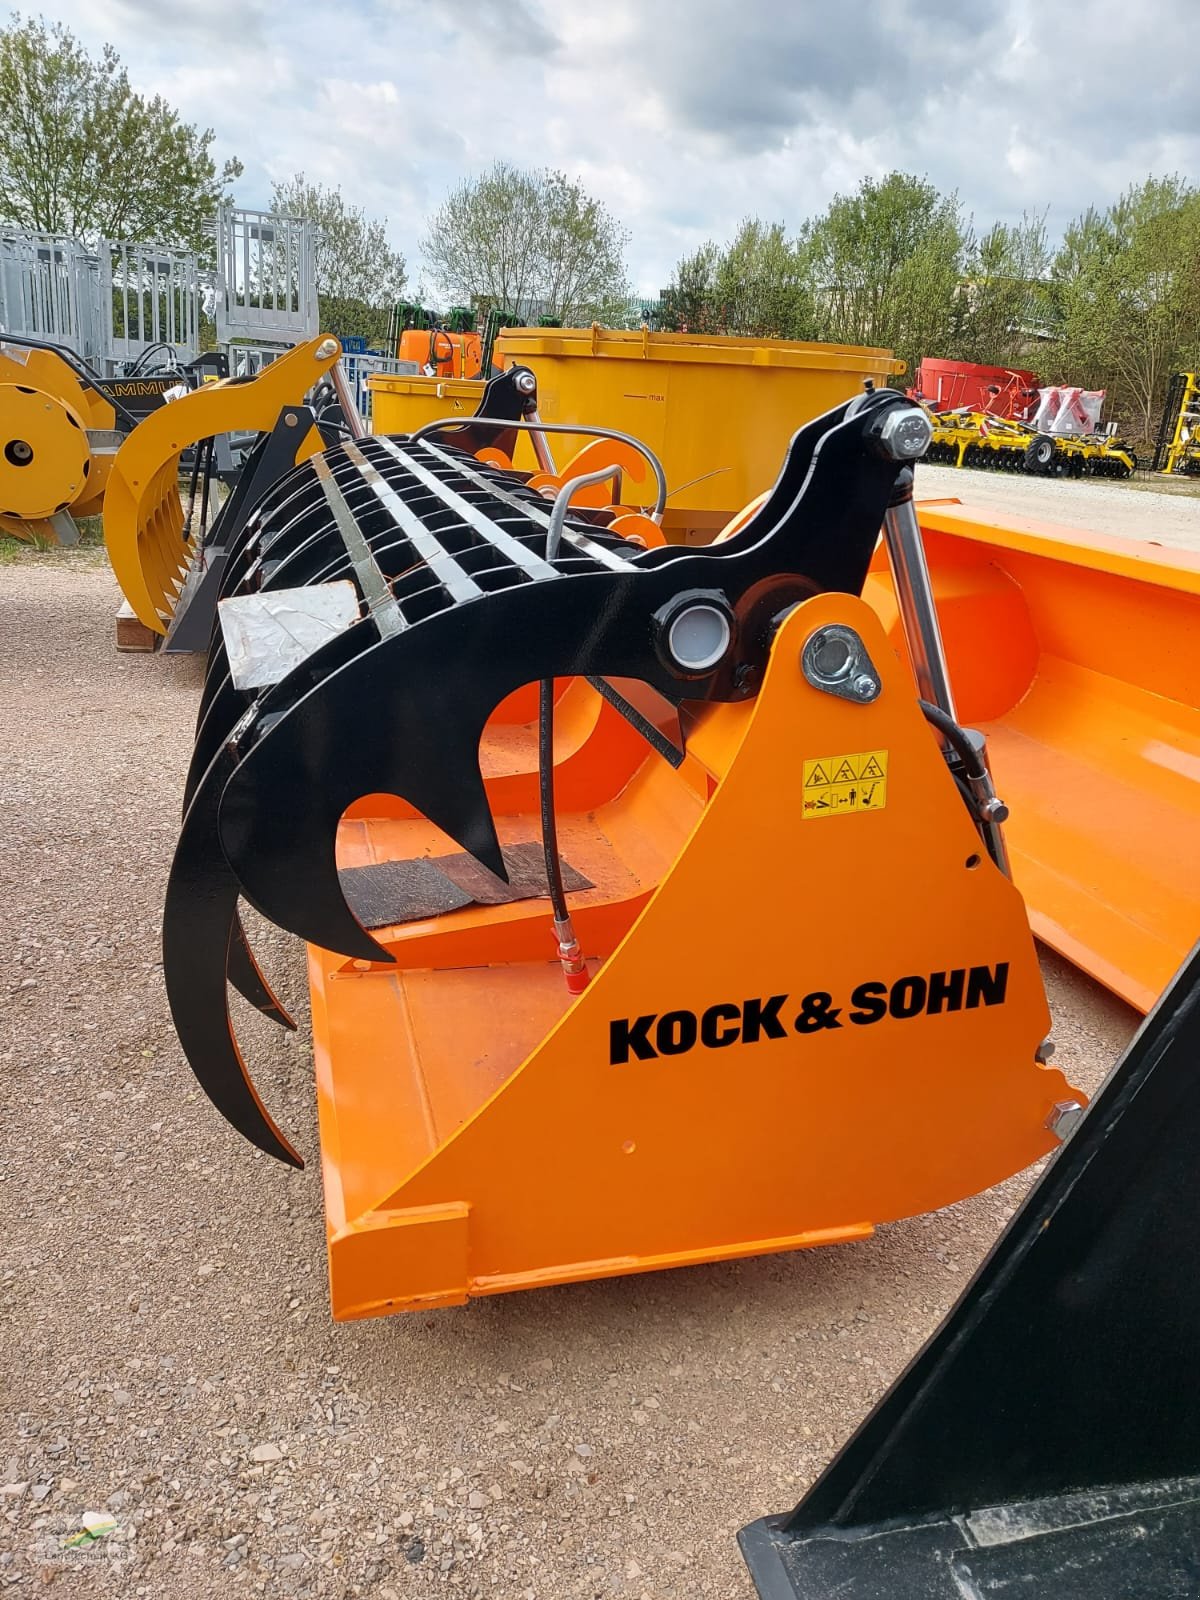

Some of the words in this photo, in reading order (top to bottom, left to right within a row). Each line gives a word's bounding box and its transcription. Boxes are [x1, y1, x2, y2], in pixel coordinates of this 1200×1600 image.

[610, 994, 788, 1065] KOCK
[795, 991, 843, 1034] &
[849, 962, 1009, 1026] SOHN
